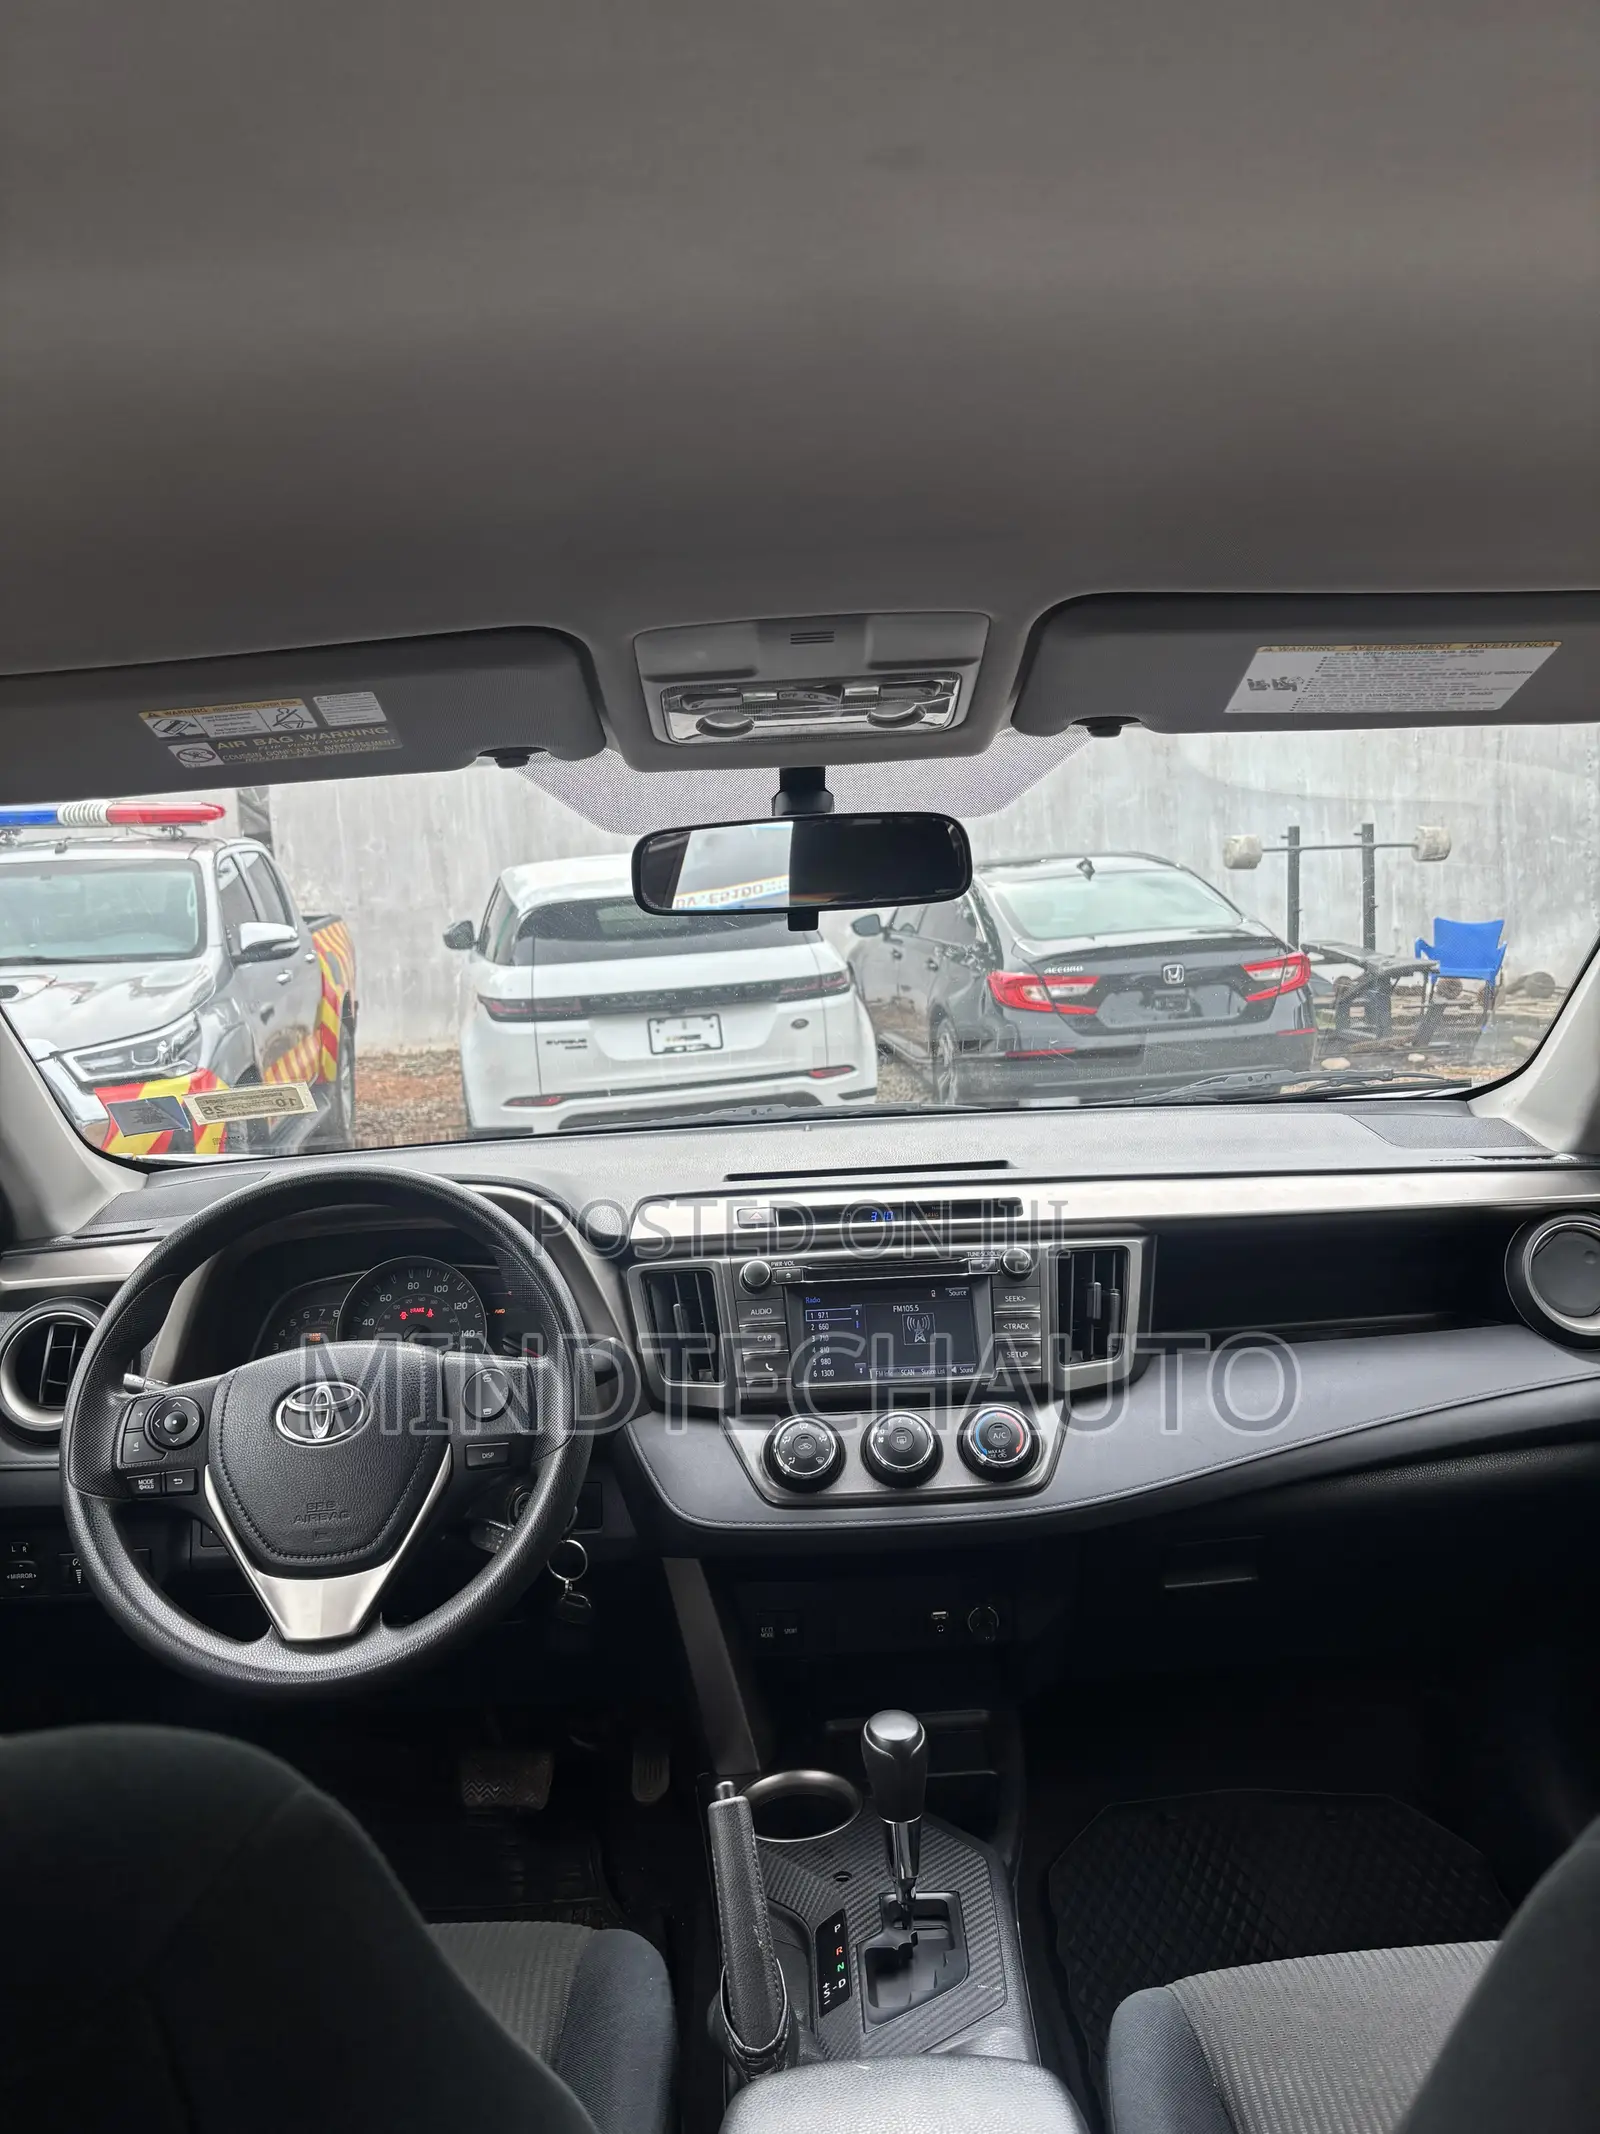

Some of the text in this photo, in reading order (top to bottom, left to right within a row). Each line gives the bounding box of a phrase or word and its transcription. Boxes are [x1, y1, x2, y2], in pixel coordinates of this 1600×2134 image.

[164, 707, 208, 717] WARNING
[217, 726, 390, 750] AIR BAG WARNING
[407, 1281, 420, 1290] 80
[433, 1284, 449, 1293] 100
[379, 1293, 392, 1302] 60
[948, 1289, 967, 1297] Source
[805, 1296, 821, 1304] Radio
[454, 1301, 468, 1310] 120
[892, 1304, 920, 1313] FM105.5
[302, 1310, 310, 1319] 6
[318, 1308, 326, 1317] 7
[332, 1309, 341, 1318] 8
[750, 1307, 773, 1316] AUDIO
[817, 1311, 829, 1319] 97.1
[362, 1317, 375, 1327] 40
[461, 1329, 476, 1338] 140
[757, 1334, 772, 1342] CAR
[1006, 1351, 1029, 1359] SETUP
[820, 1369, 835, 1377] 1300
[900, 1369, 916, 1377] SCAN
[959, 1366, 974, 1374] Sound
[992, 1431, 1008, 1439] A/C
[481, 1451, 495, 1459] DISP
[293, 1510, 351, 1524] AIRBAG
[10, 1572, 33, 1580] MIRROR
[834, 1923, 841, 1933] P
[835, 1946, 843, 1956] R
[836, 1961, 845, 1972] N
[838, 1978, 846, 1989] D
